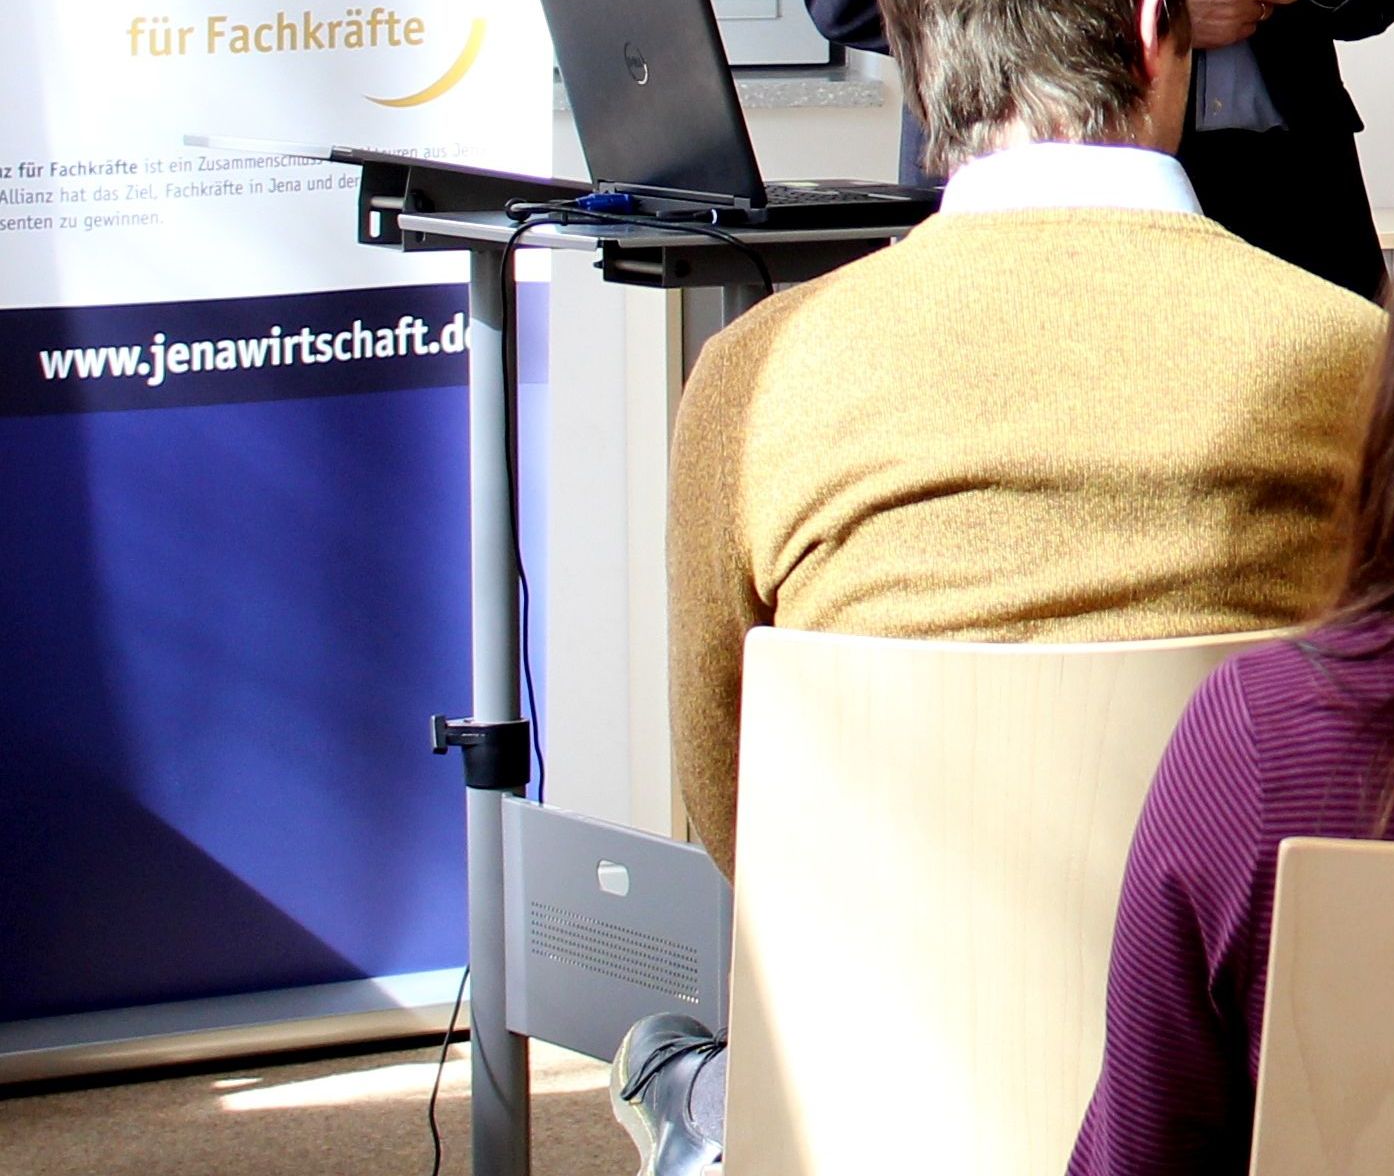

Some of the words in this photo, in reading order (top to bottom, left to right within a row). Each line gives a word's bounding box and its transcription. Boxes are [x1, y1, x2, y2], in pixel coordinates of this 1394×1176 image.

[126, 16, 194, 57] für
[206, 8, 426, 56] Fachkräfte
[18, 162, 43, 179] für
[50, 159, 138, 178] Fachkräfte
[169, 158, 193, 173] ein
[0, 187, 54, 205] Allianz
[60, 187, 87, 203] hat
[93, 185, 119, 202] das
[166, 181, 244, 199] Fachkräfte
[249, 179, 263, 194] in
[268, 178, 301, 194] Jena
[307, 175, 333, 191] und
[59, 216, 77, 229] zu
